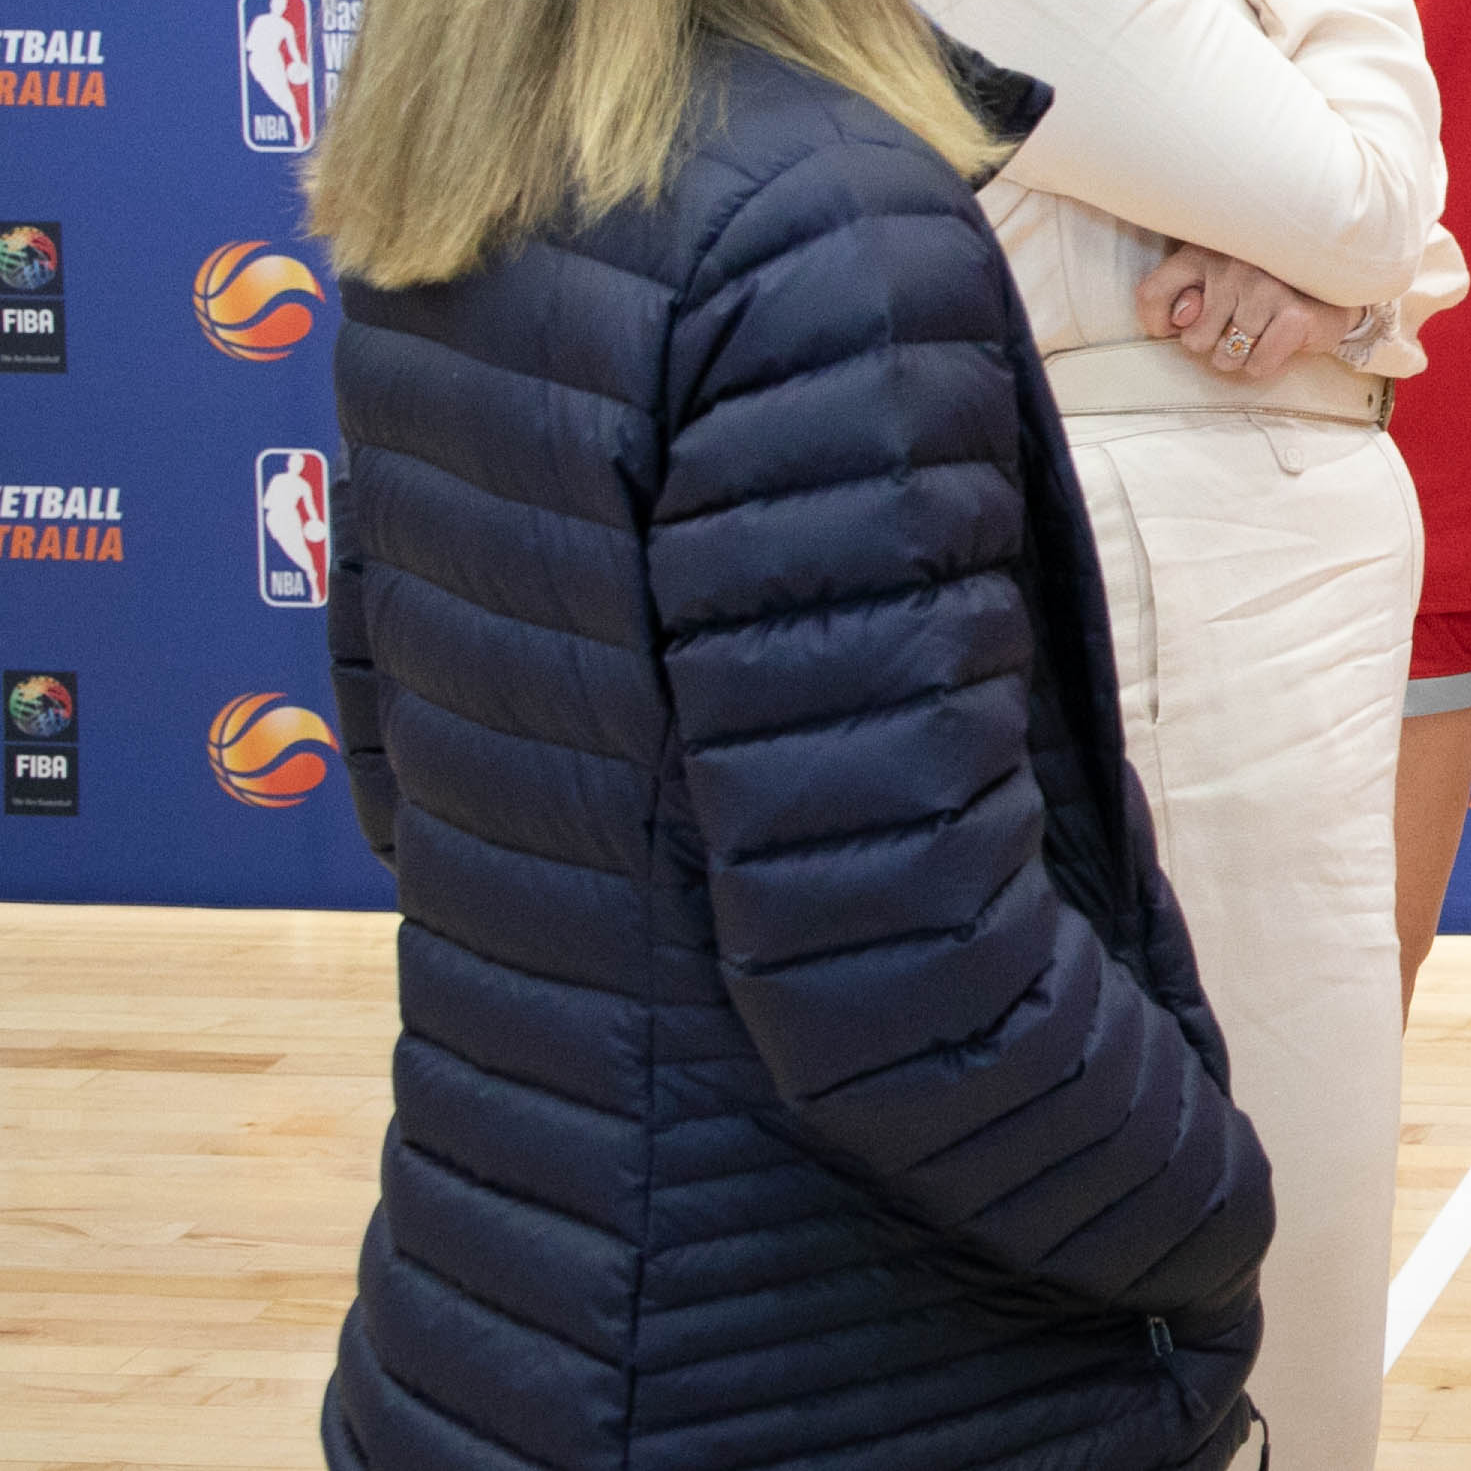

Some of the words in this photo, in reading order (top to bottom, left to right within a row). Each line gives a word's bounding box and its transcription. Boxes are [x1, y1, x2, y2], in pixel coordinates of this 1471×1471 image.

[254, 115, 288, 140] NBA
[3, 309, 53, 333] FIBA
[0, 486, 121, 519] ETBALL
[271, 571, 304, 596] NBA
[16, 755, 66, 778] FIBA
